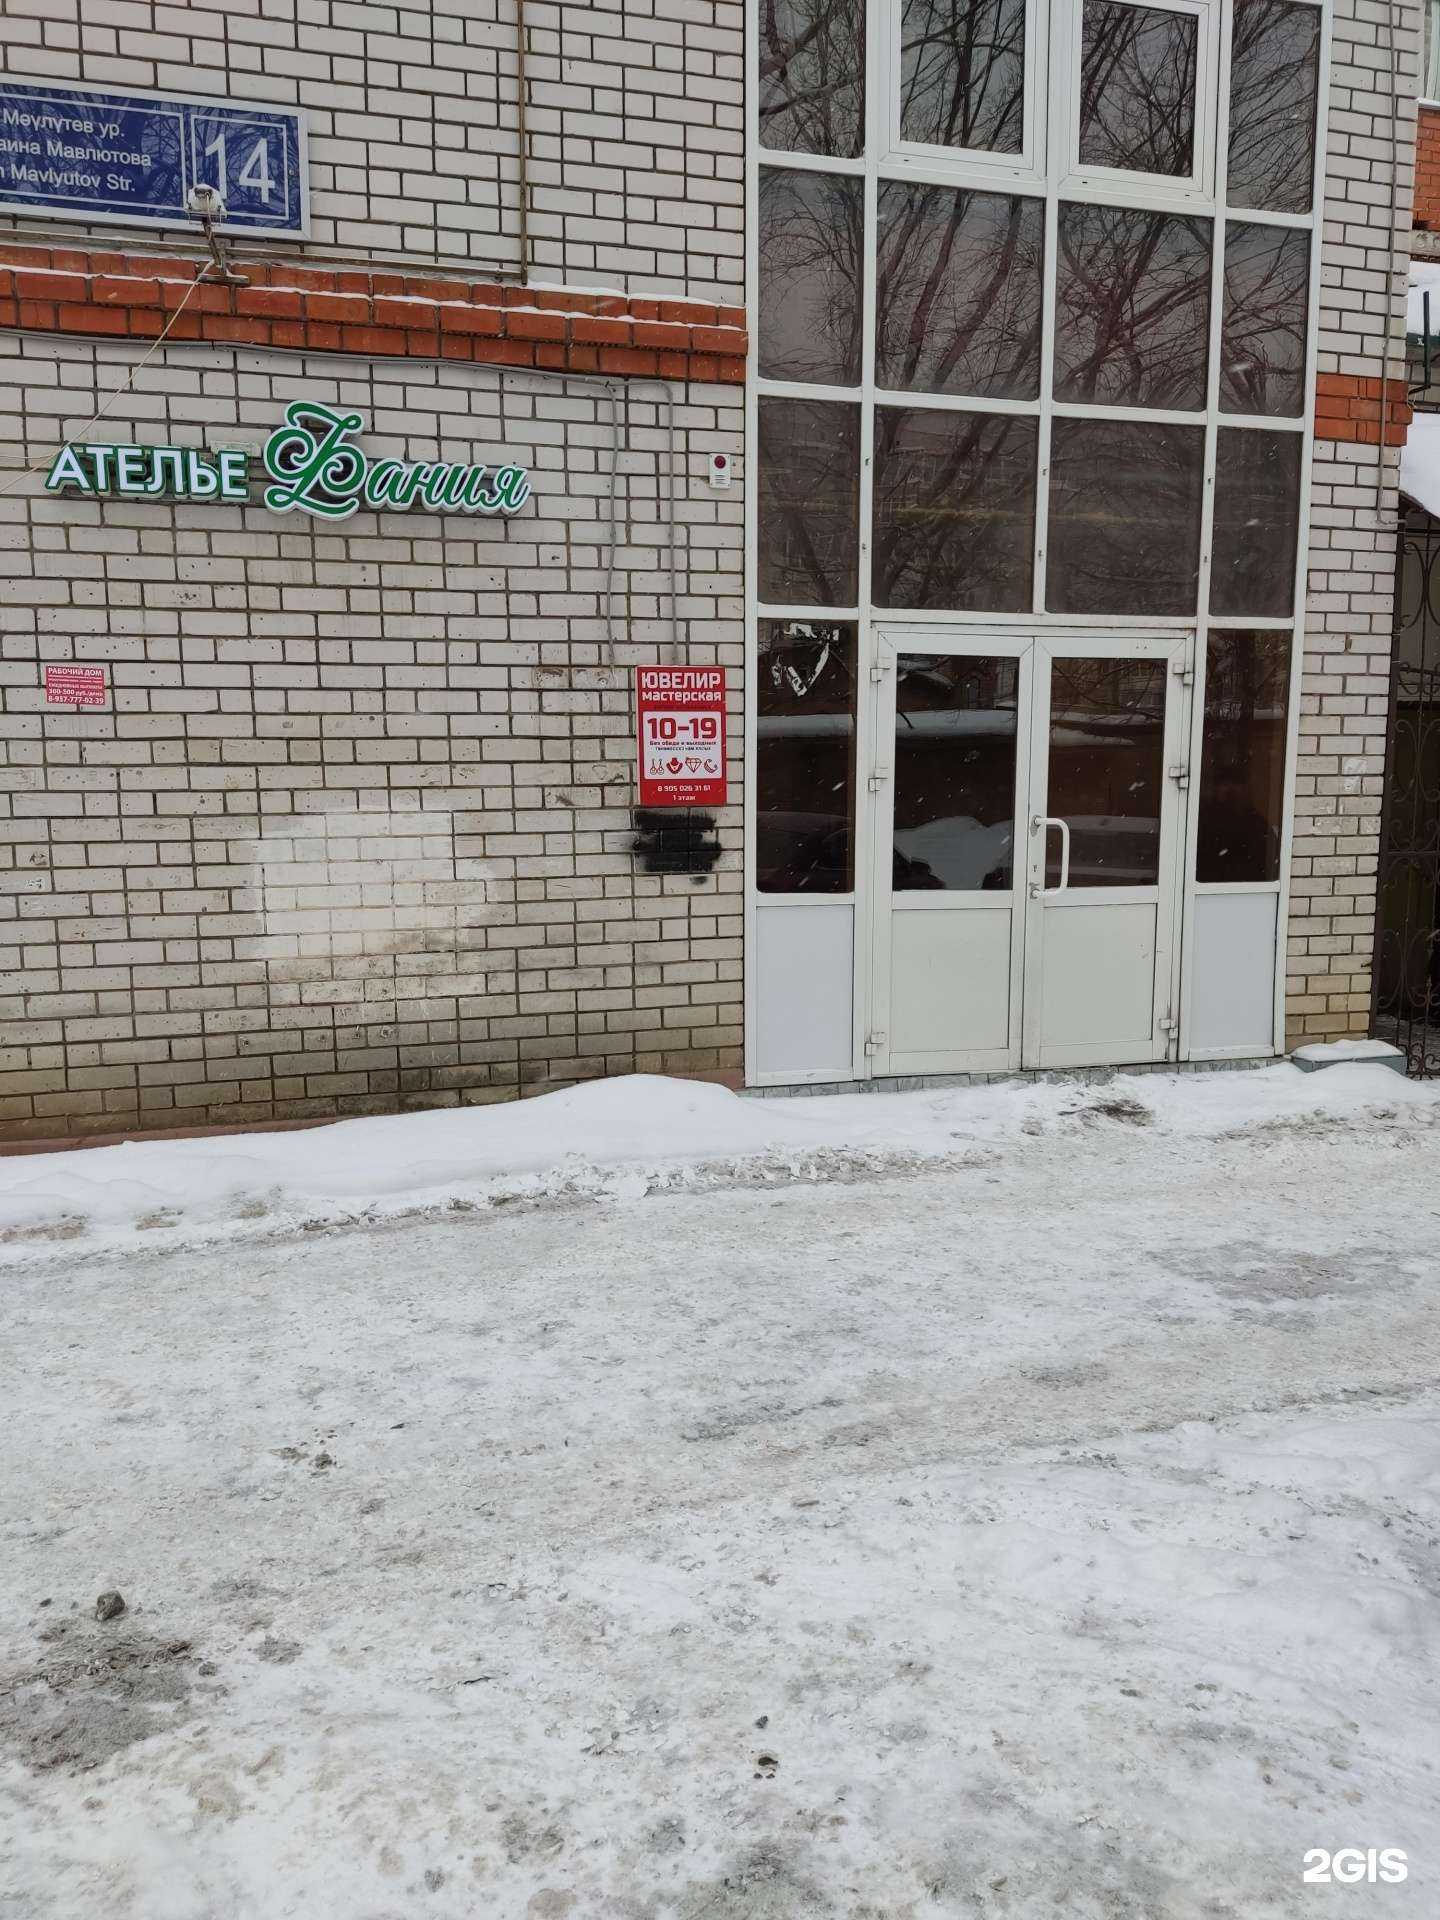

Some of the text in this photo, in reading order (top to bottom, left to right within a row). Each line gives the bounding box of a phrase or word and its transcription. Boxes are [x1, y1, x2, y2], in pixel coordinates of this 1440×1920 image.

[98, 121, 125, 139] ур.
[47, 139, 151, 167] Мавлютова
[11, 163, 100, 189] Mavlyutov
[106, 173, 136, 192] Str.
[205, 132, 276, 203] 14
[47, 444, 249, 498] АТЕЛЬЕ
[48, 667, 83, 676] РАБОЧИЙ
[84, 669, 102, 677] ДОМ
[641, 672, 721, 689] ЮВЕЛИР
[642, 691, 721, 704] мастерская
[647, 717, 717, 739] 10-19
